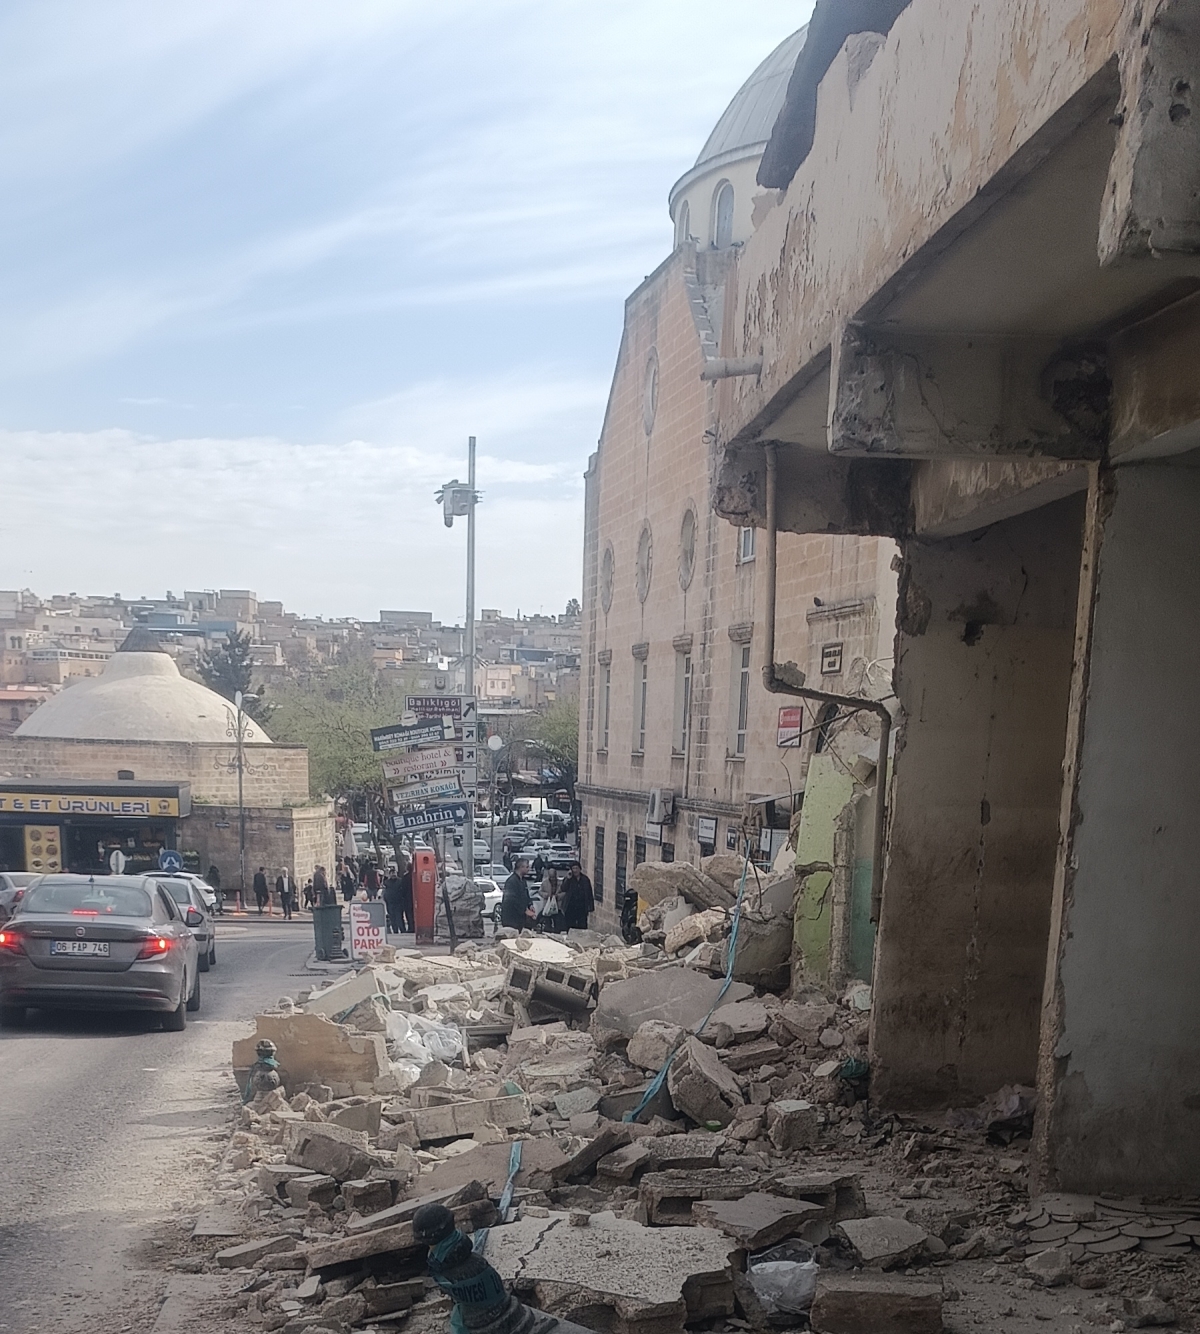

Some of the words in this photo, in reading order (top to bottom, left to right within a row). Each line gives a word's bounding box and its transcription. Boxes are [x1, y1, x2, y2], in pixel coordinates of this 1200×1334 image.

[409, 698, 460, 708] Balıklıgöl
[385, 755, 419, 767] boutique
[421, 749, 441, 761] hotel
[443, 749, 452, 757] &
[14, 799, 25, 809] &
[30, 800, 53, 811] ET
[58, 797, 150, 813] ÜRÜNLERİ
[407, 809, 454, 827] nahrin
[356, 926, 380, 937] OTO
[56, 942, 67, 951] 06
[72, 942, 88, 952] FAP
[92, 943, 108, 953] 746
[353, 938, 384, 950] PARK
